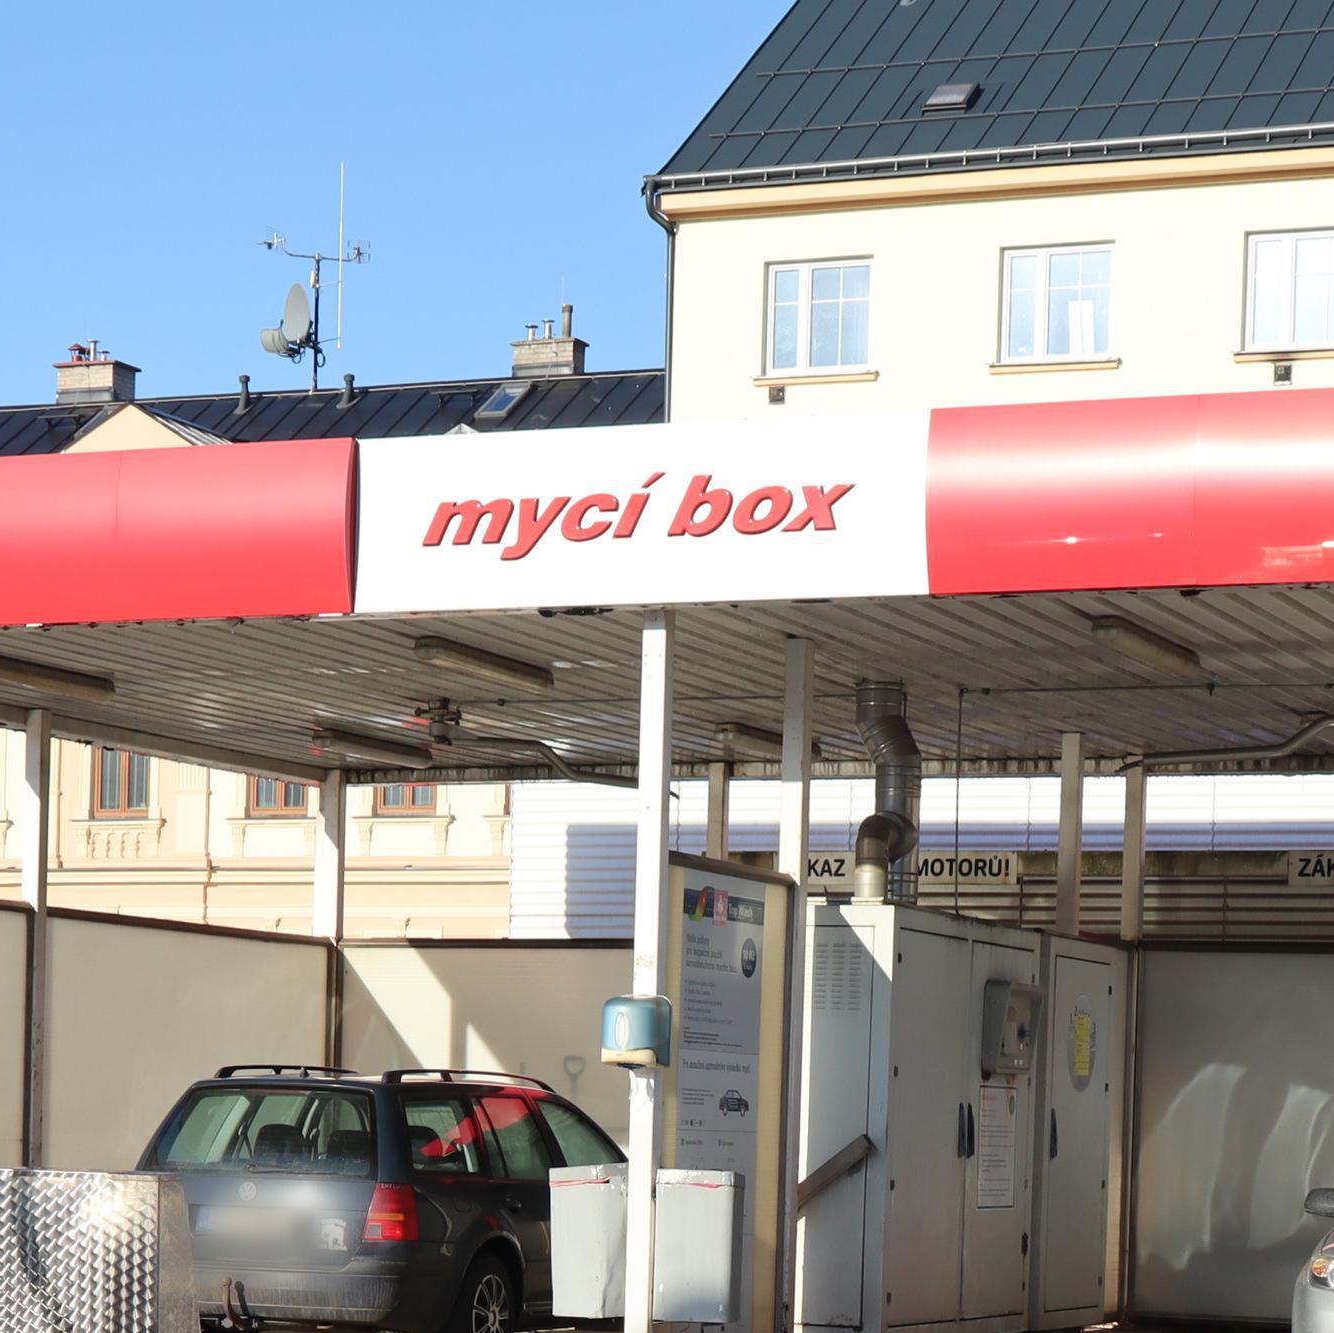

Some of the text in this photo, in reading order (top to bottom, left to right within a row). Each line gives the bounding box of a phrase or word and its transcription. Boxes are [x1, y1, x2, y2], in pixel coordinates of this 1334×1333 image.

[422, 472, 855, 561] mycí box
[807, 858, 846, 877] KAZ
